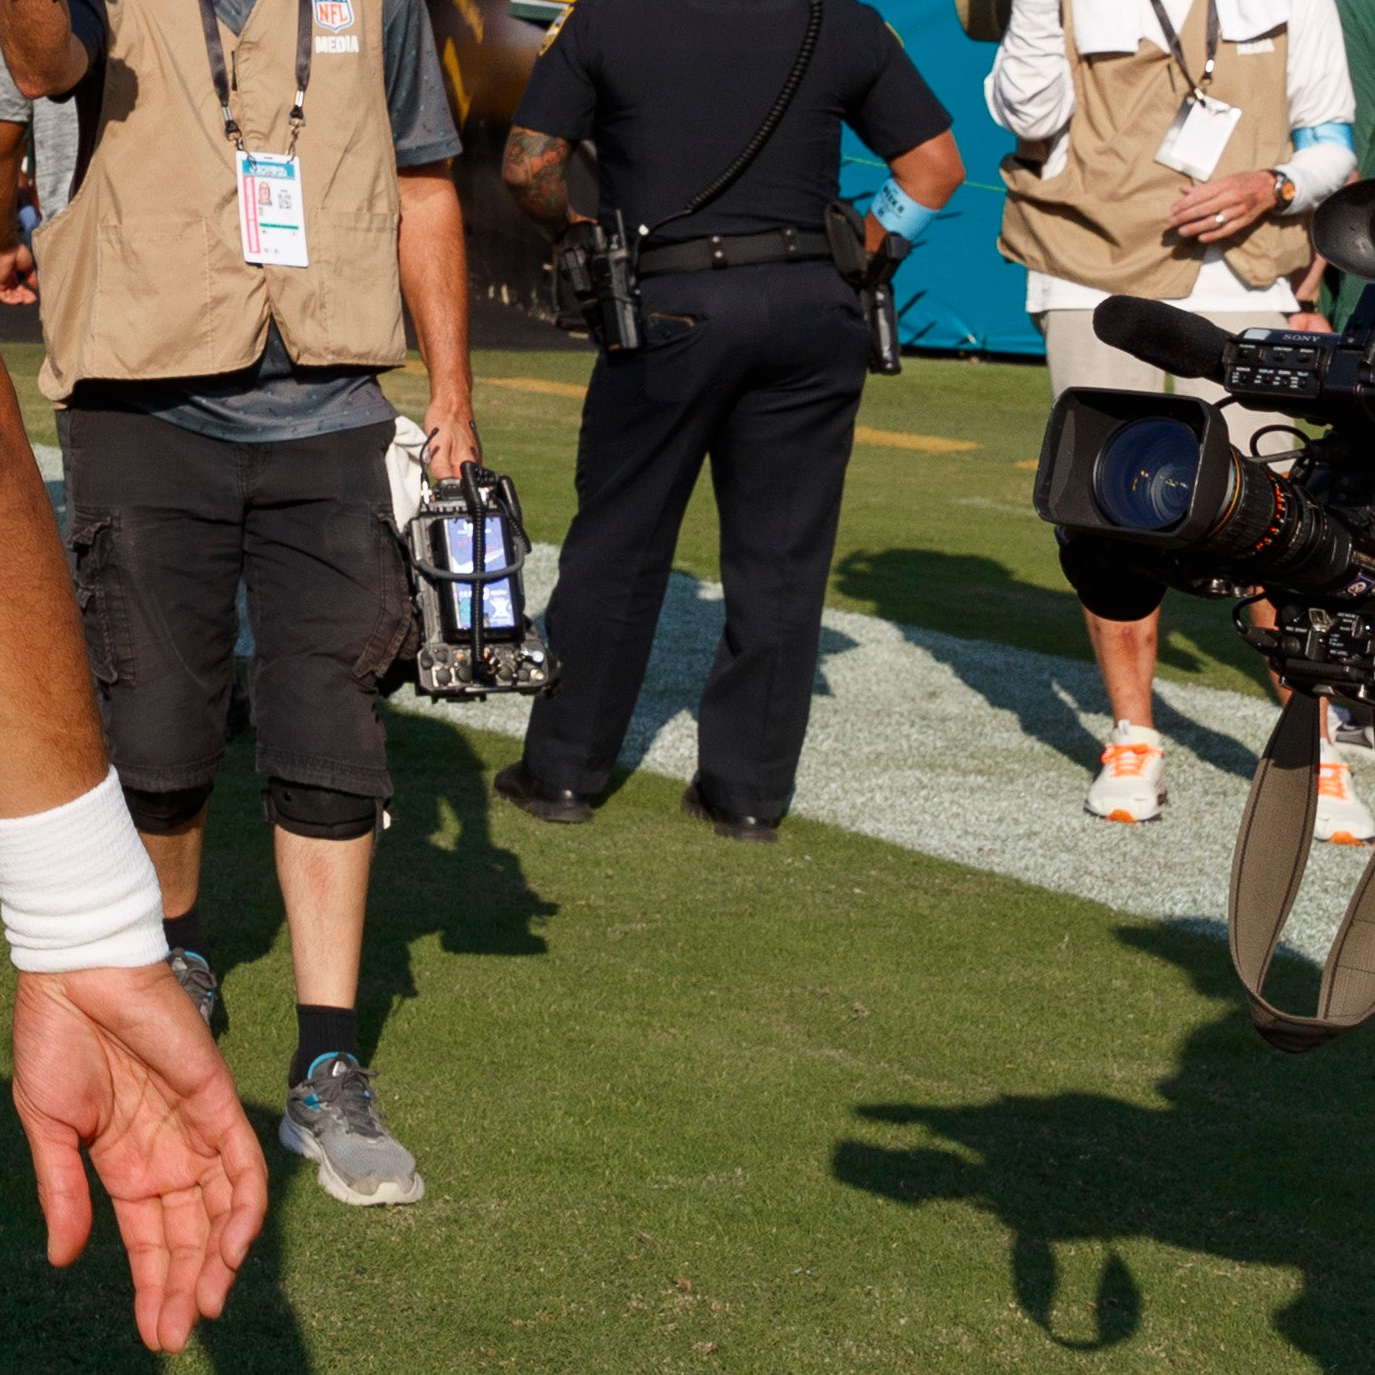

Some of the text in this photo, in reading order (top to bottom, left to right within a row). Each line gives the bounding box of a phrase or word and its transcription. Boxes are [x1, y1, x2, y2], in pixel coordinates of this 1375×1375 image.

[318, 4, 349, 25] NFL
[314, 34, 360, 54] MEDIA
[1282, 333, 1321, 343] SONY
